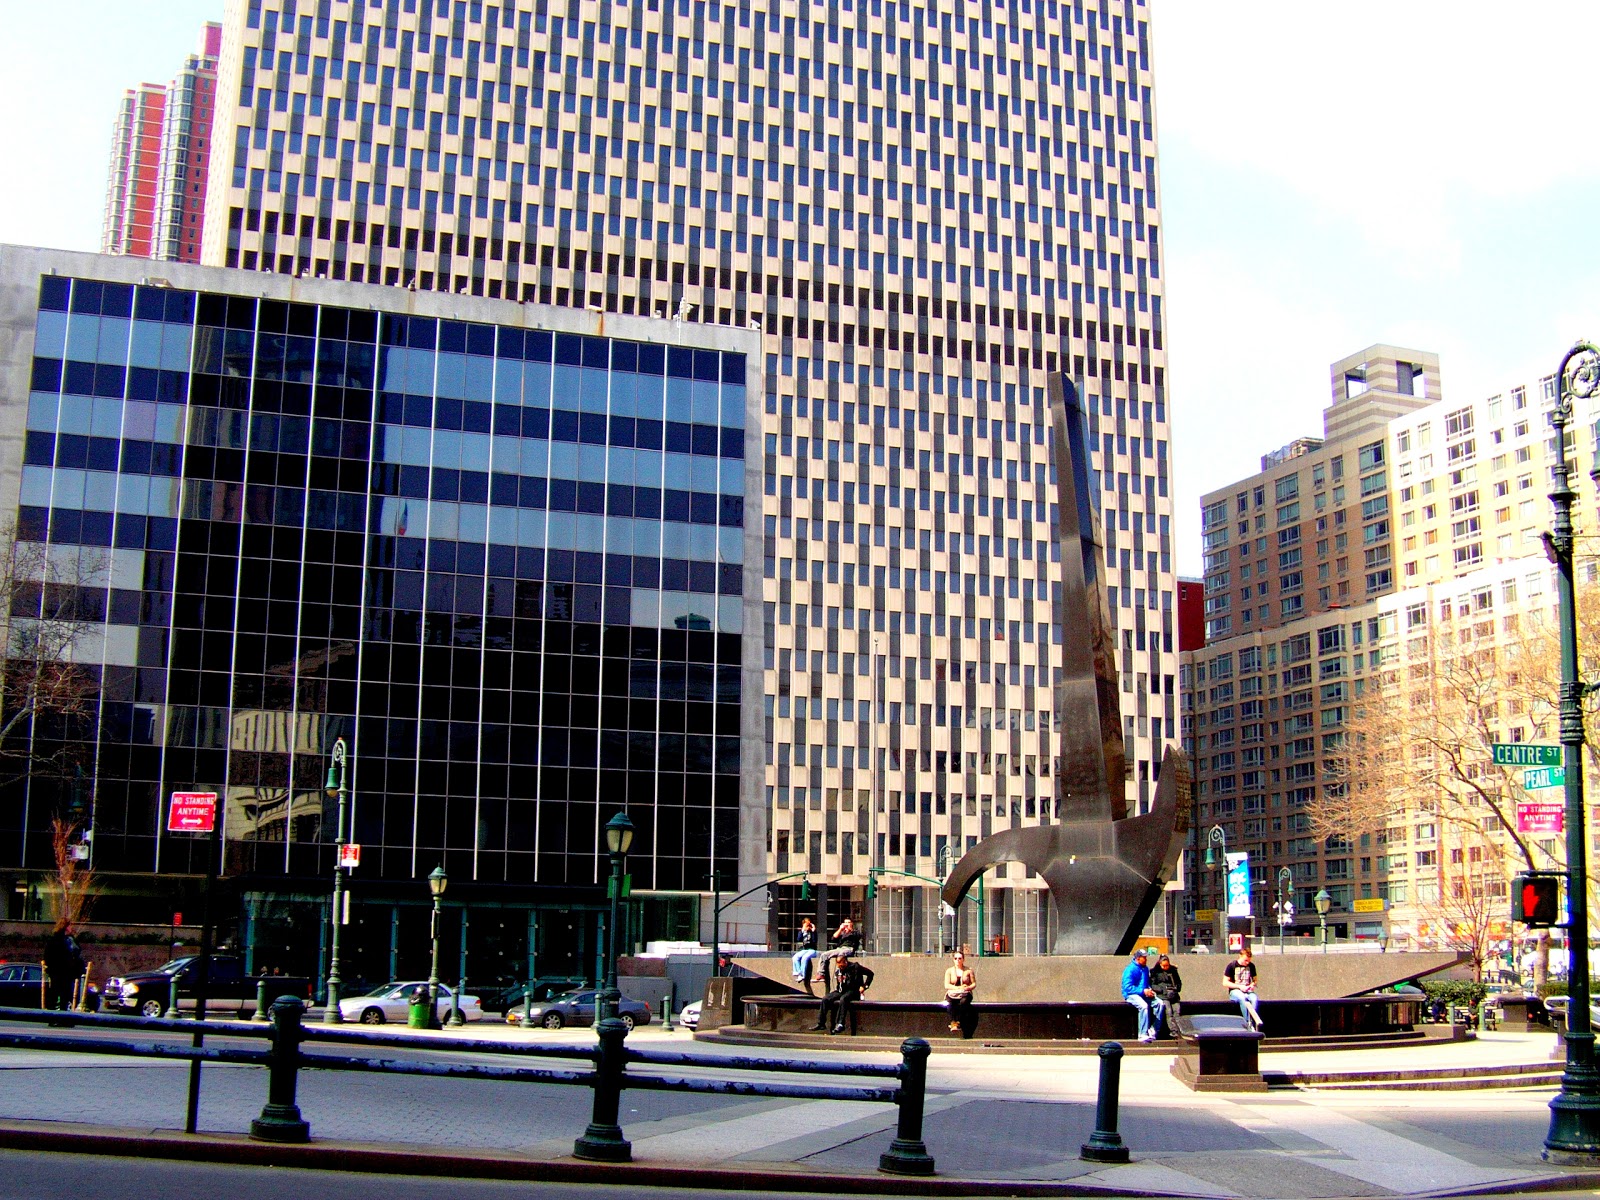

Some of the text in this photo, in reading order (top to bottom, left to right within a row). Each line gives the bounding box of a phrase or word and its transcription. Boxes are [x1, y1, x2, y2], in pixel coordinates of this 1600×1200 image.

[1497, 746, 1558, 764] CENTRE ST
[1525, 769, 1551, 788] PEARL
[173, 797, 214, 805] NO STANDING
[177, 808, 209, 816] ANYTIME
